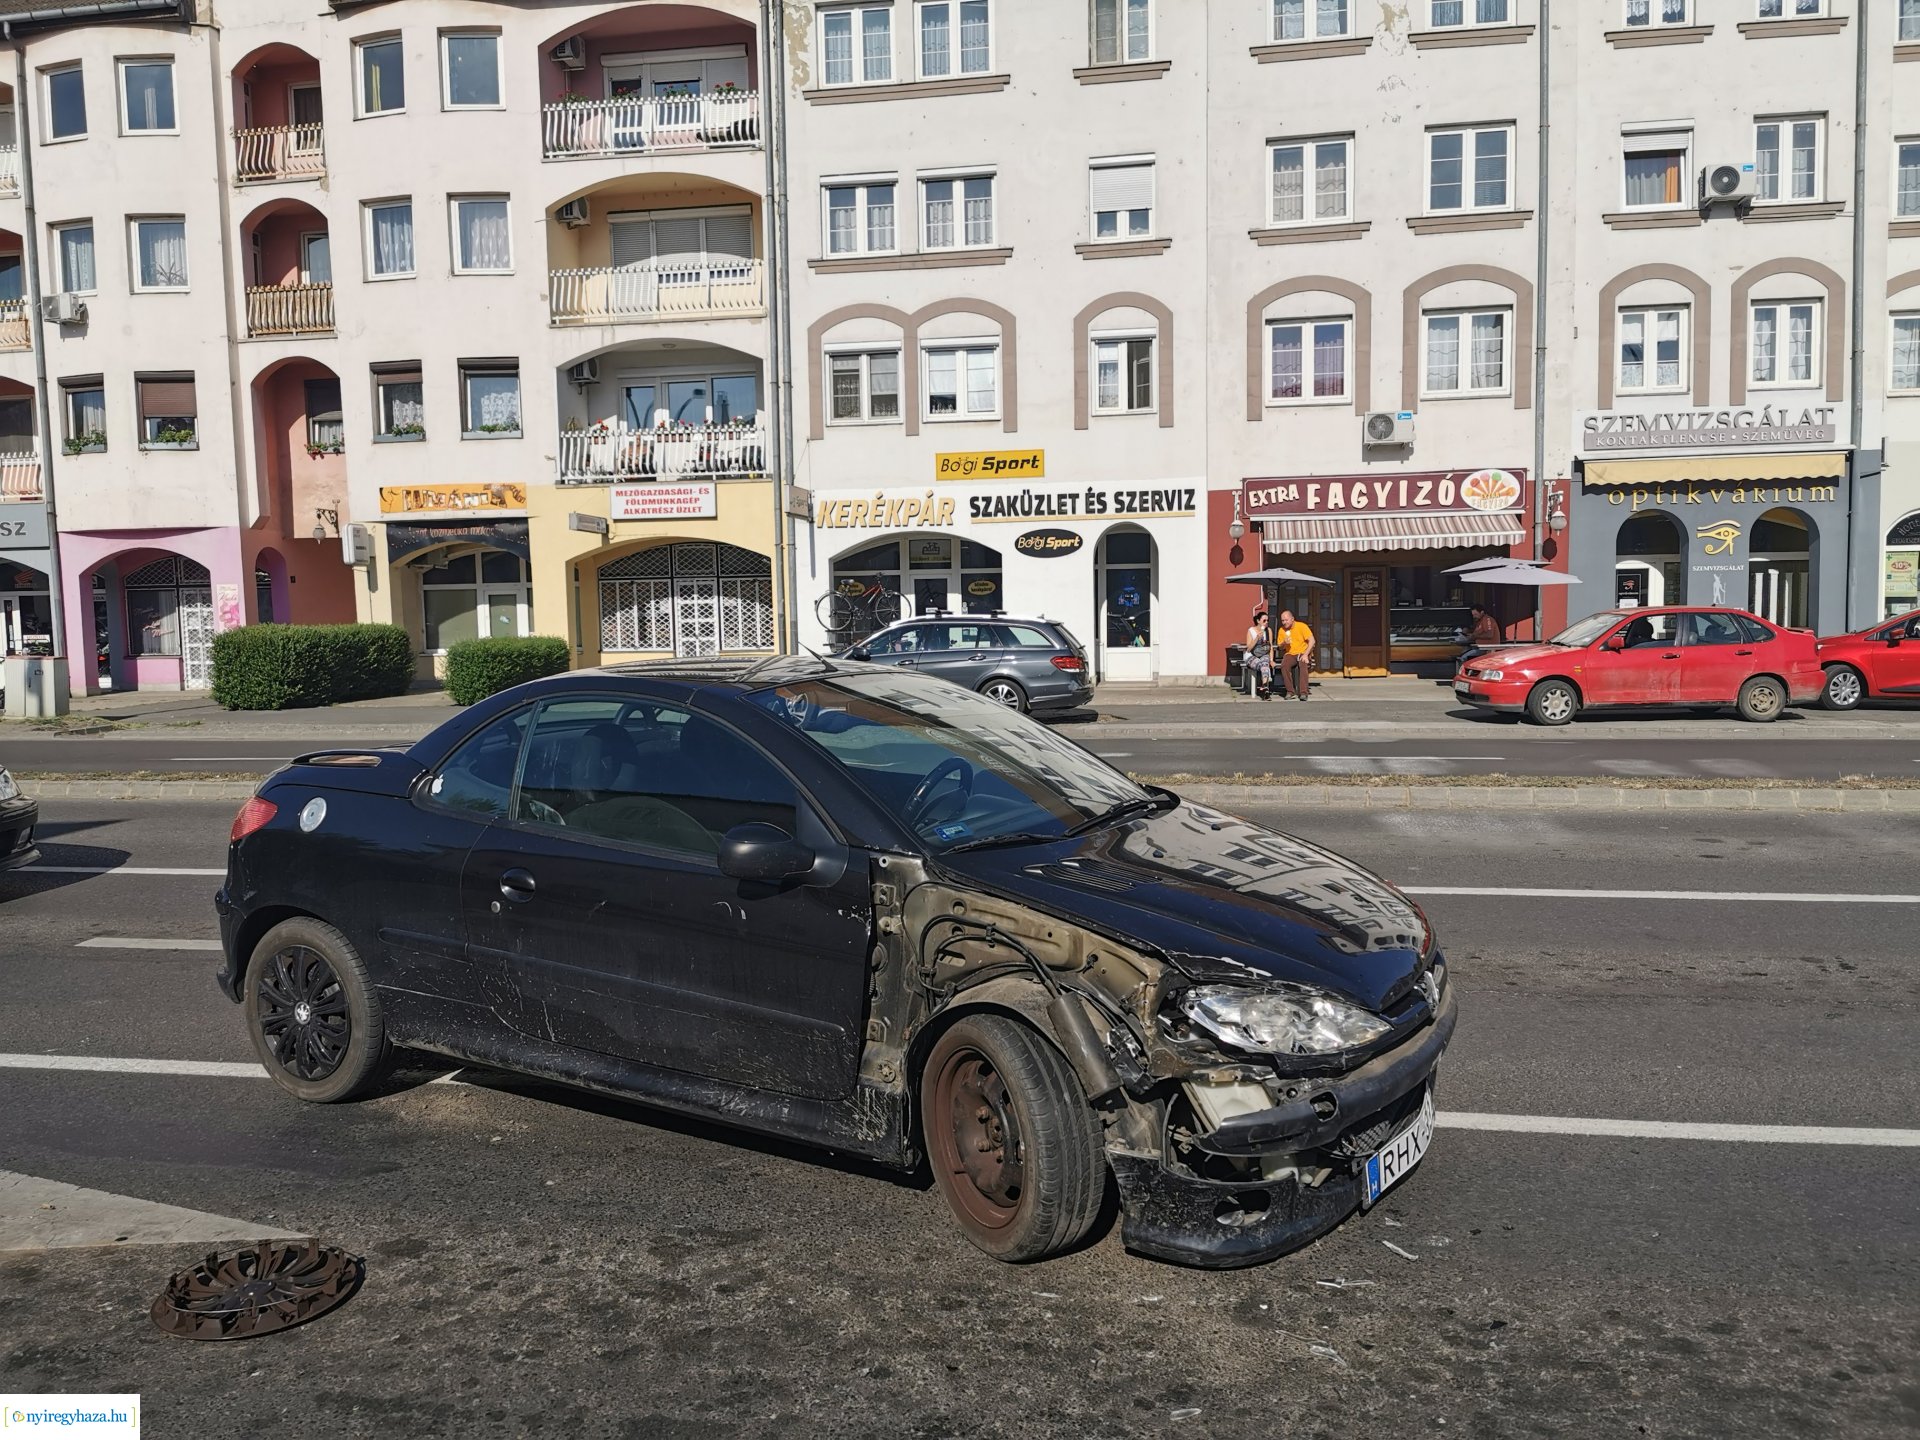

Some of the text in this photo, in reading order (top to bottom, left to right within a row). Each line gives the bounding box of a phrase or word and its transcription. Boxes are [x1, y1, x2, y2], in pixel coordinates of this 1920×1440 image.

[1583, 404, 1835, 434] SZEMVIZSGÁLAT
[1595, 429, 1825, 447] KONTAKTLENCSE SZEMÜVEG
[981, 455, 1039, 474] Sport
[1248, 473, 1456, 510] EXTRA FAGYIZÓ
[623, 506, 703, 515] ALKATRÉSZ ÜZLET
[625, 497, 700, 506] FÖLDMUNKAGÉP
[816, 490, 956, 529] KERÉKPÁR
[969, 489, 1080, 518] SZAKÜZLET
[1084, 486, 1108, 514] ÉS
[1114, 488, 1196, 513] SZERVIZ
[1046, 535, 1080, 550] Sport
